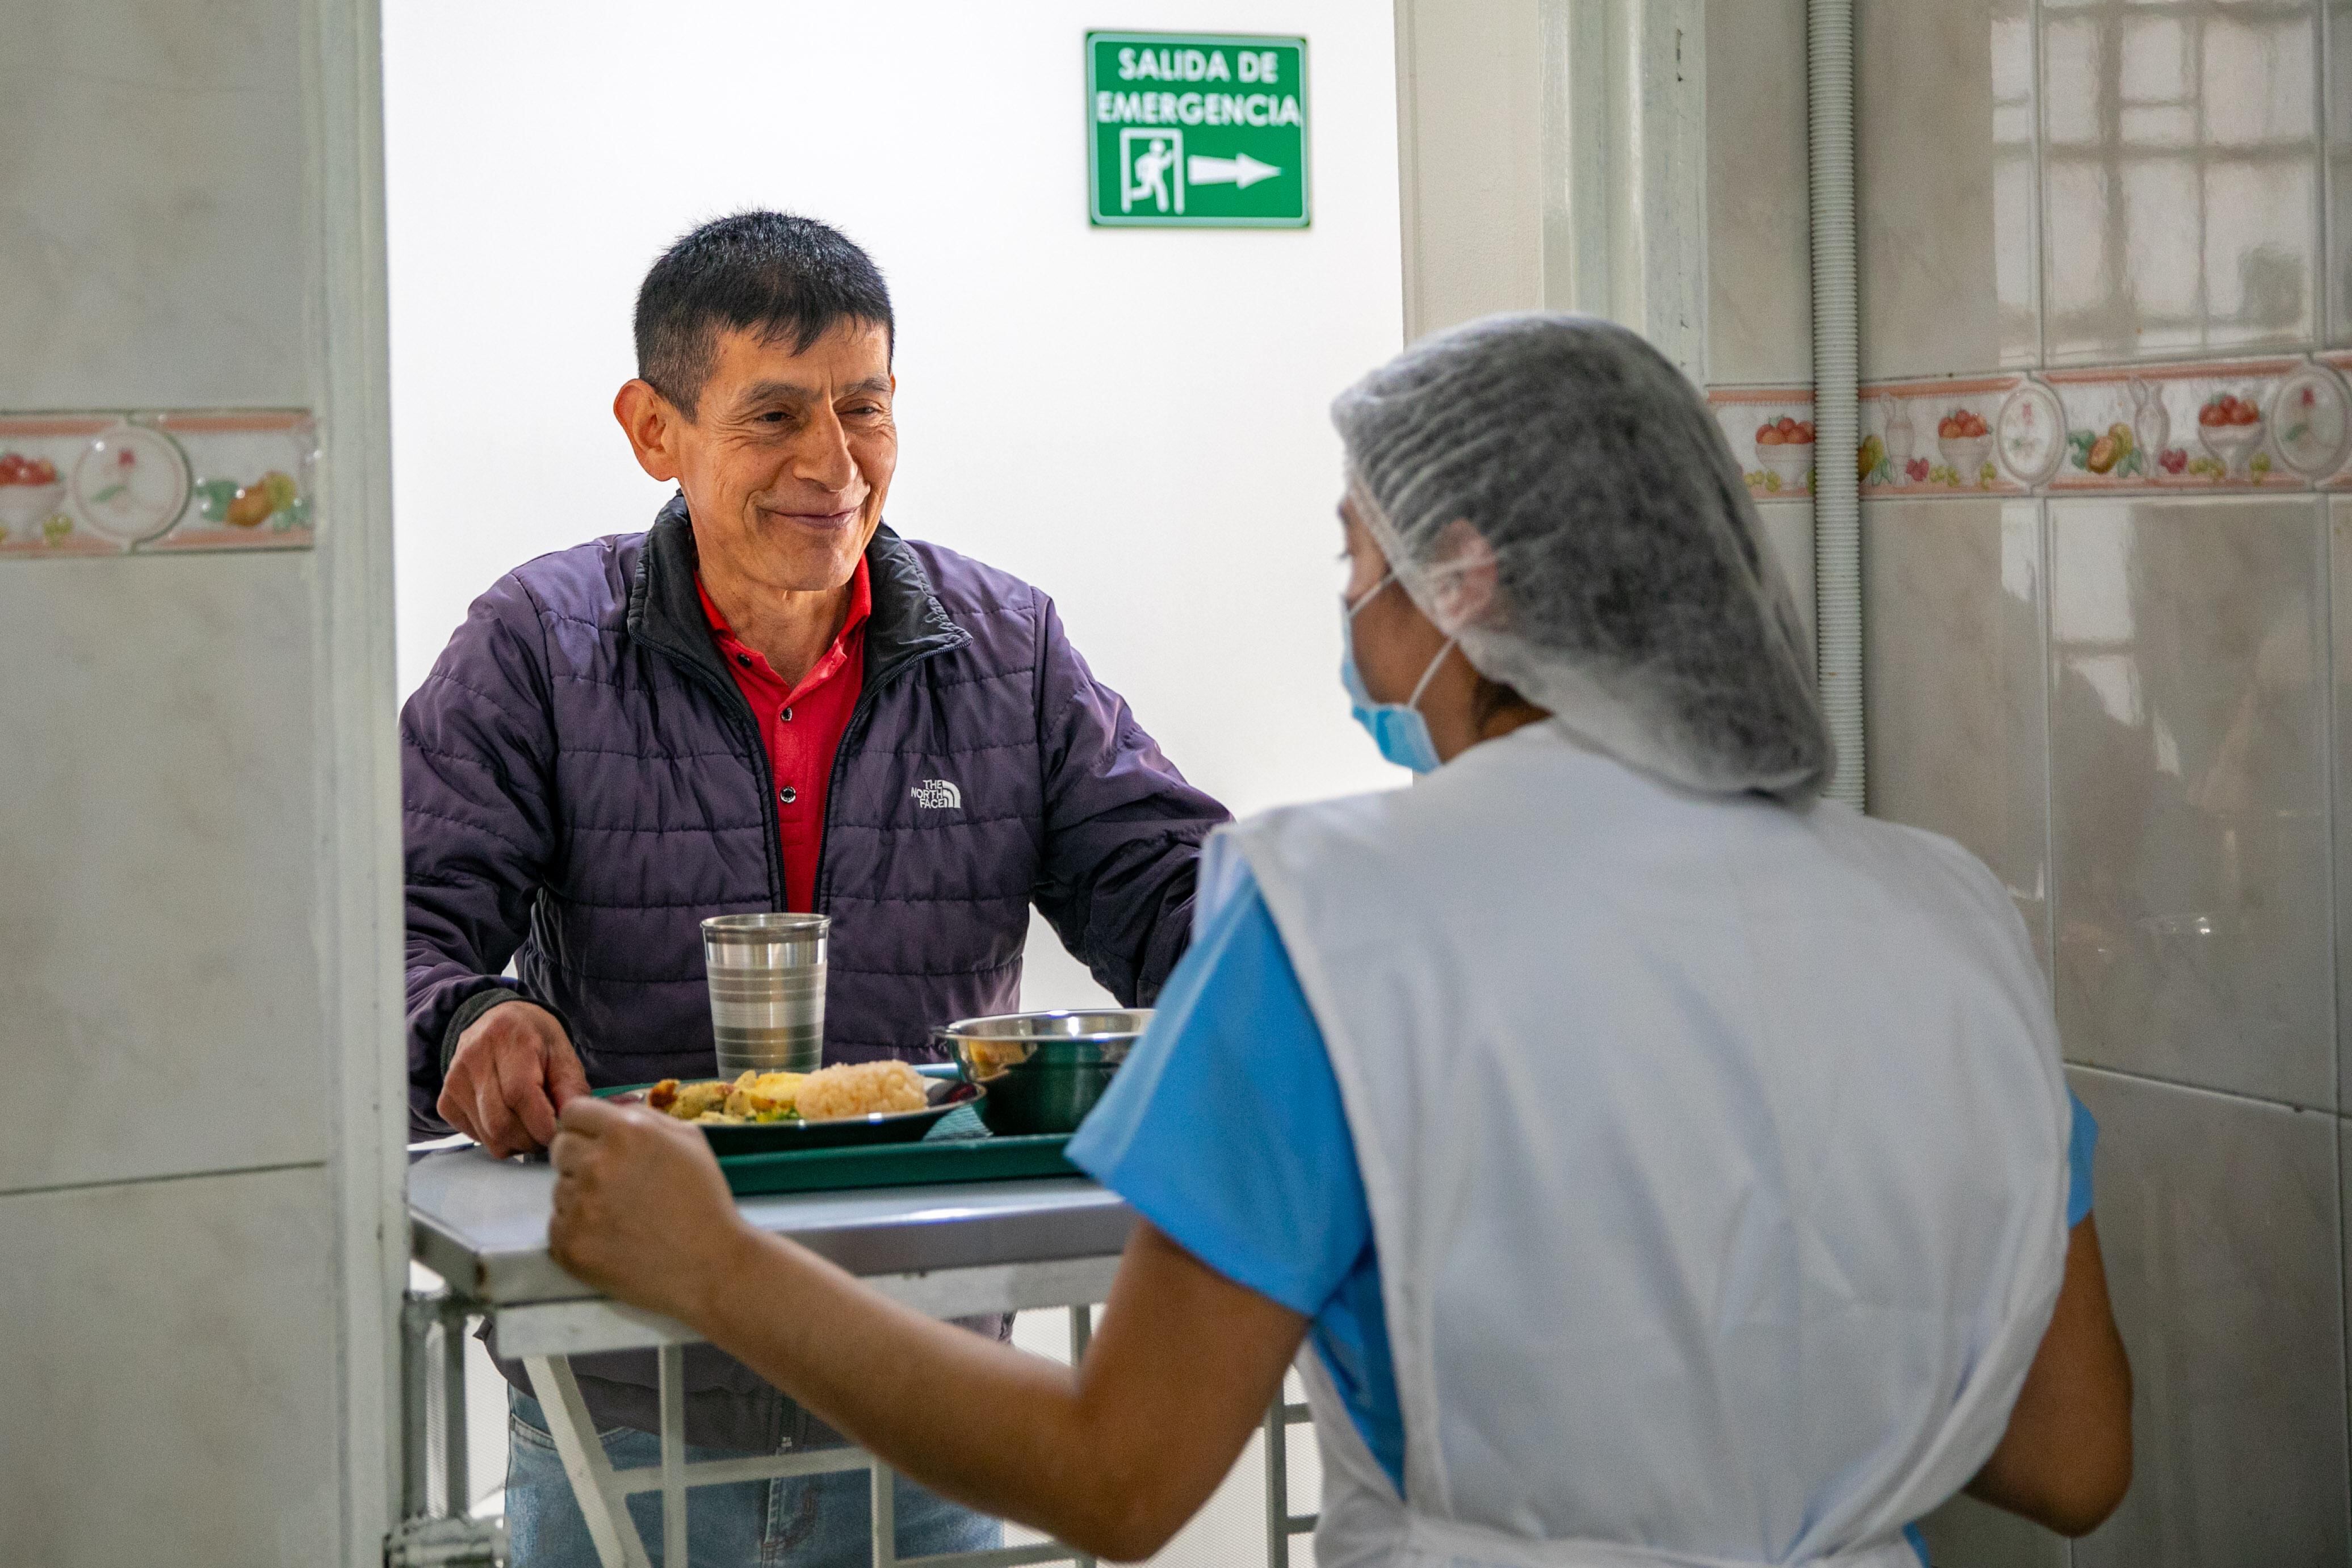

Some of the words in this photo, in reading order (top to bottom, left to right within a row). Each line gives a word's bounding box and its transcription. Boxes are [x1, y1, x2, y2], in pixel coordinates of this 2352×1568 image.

[1118, 48, 1231, 82] SALIDA
[1238, 51, 1278, 84] DE
[1097, 91, 1301, 127] EMERGENCIA
[923, 779, 942, 789] THE
[911, 787, 943, 799] NORTH
[920, 798, 945, 808] FACE
